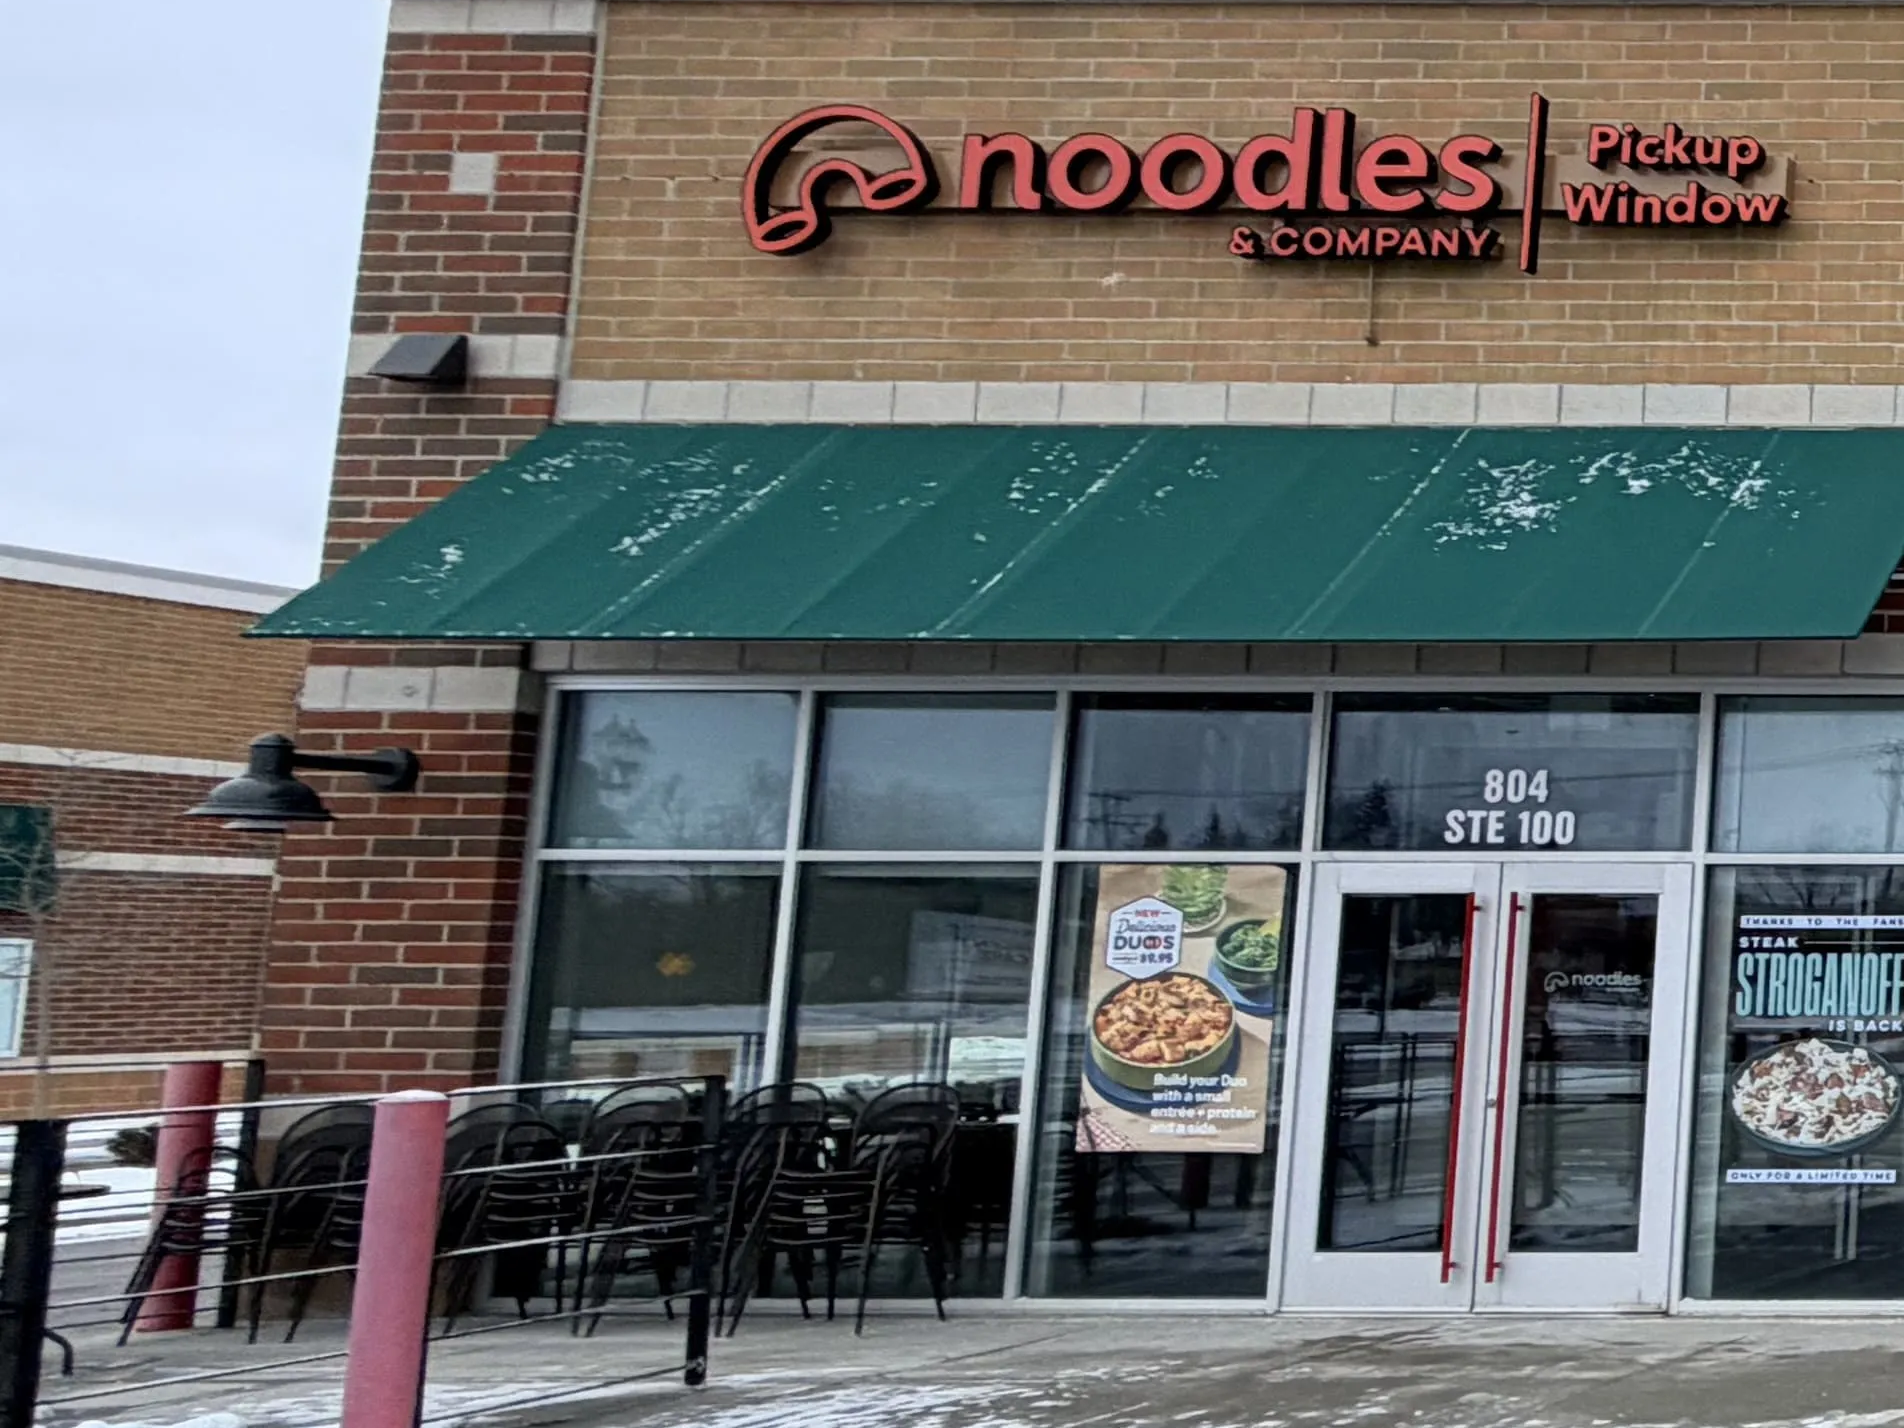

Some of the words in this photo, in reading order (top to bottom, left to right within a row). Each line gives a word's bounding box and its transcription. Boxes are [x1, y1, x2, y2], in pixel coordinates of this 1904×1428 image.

[1588, 123, 1762, 178] Pickup
[959, 107, 1500, 213] noodles
[1560, 181, 1785, 224] Window
[1229, 226, 1257, 256] &
[1270, 226, 1494, 258] COMPANY
[1484, 768, 1549, 803] 804
[1444, 809, 1506, 844] STE
[1518, 810, 1575, 845] 100
[1135, 909, 1161, 918] NEW
[1745, 918, 1793, 926] THANKS
[1807, 918, 1823, 926] TO
[1836, 918, 1859, 926] THE
[1873, 918, 1904, 926] FANS
[1738, 936, 1799, 948] STEAK
[1571, 971, 1642, 986] noodles
[1828, 1020, 1846, 1032] IS
[1853, 1020, 1903, 1032] BACK
[1153, 1073, 1187, 1086] Build
[1189, 1075, 1219, 1089] your
[1221, 1074, 1247, 1087] Duo
[1152, 1090, 1182, 1102] with
[1183, 1092, 1193, 1102] a
[1195, 1090, 1231, 1102] small
[1207, 1107, 1257, 1119] protein
[1731, 1172, 1761, 1180] ONLY
[1767, 1172, 1790, 1180] FOR
[1807, 1172, 1857, 1180] LIMITED
[1862, 1172, 1892, 1180] TIME
